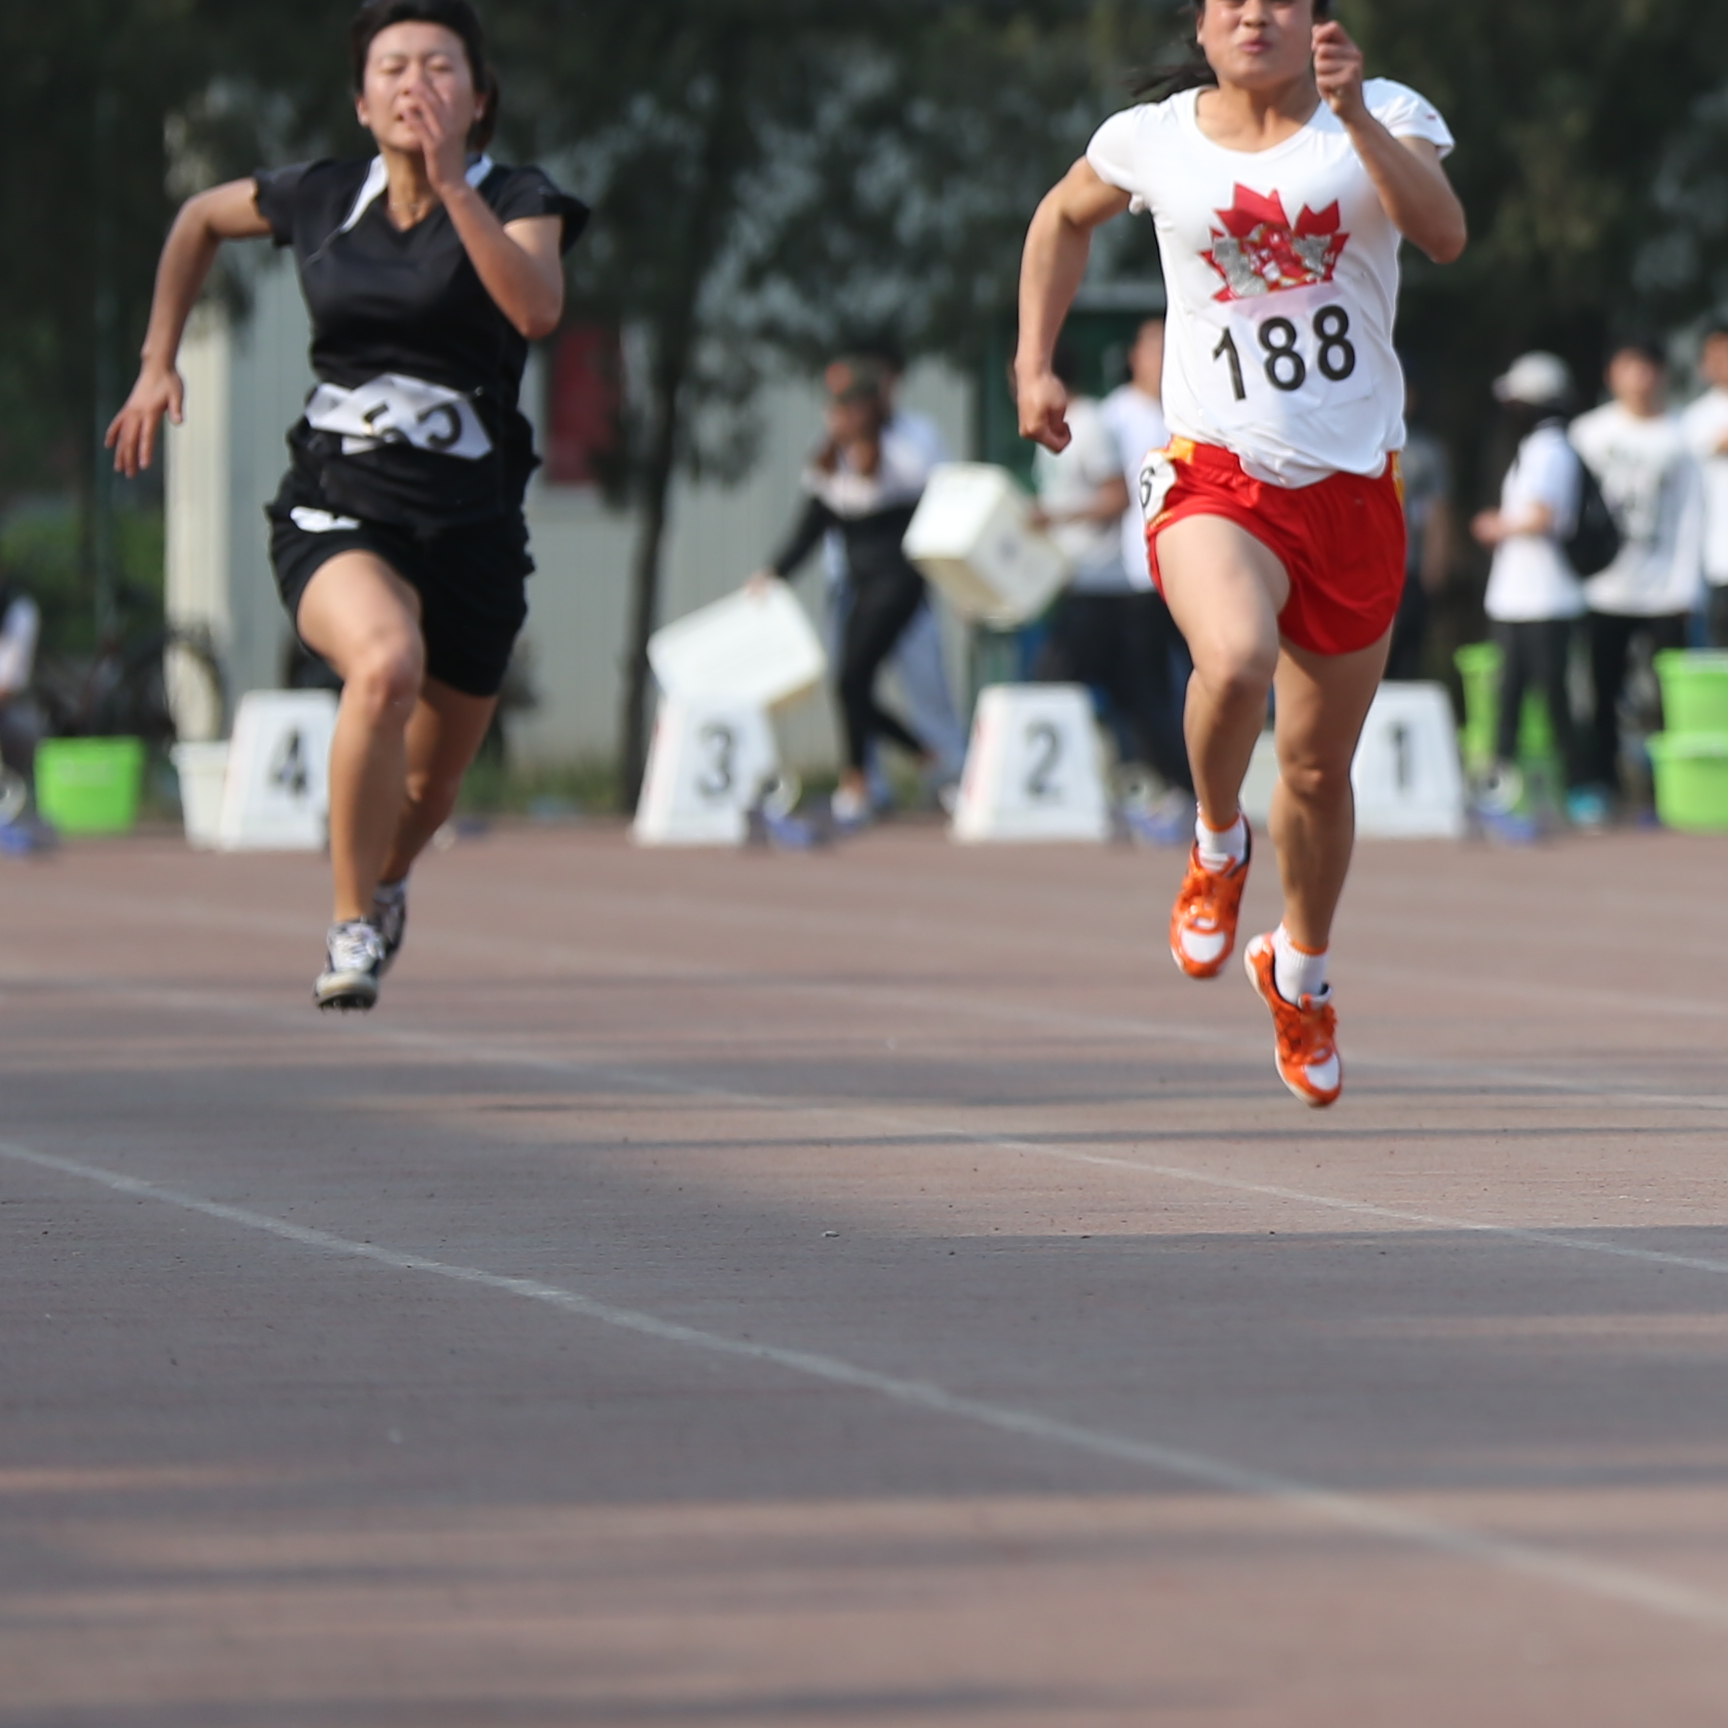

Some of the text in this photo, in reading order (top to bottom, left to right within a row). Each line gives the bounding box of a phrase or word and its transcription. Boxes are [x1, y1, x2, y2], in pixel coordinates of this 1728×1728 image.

[1213, 305, 1356, 402] 188
[267, 724, 310, 798] 4
[698, 722, 735, 798] 3
[1023, 720, 1063, 802] 2
[1384, 720, 1413, 795] 1
